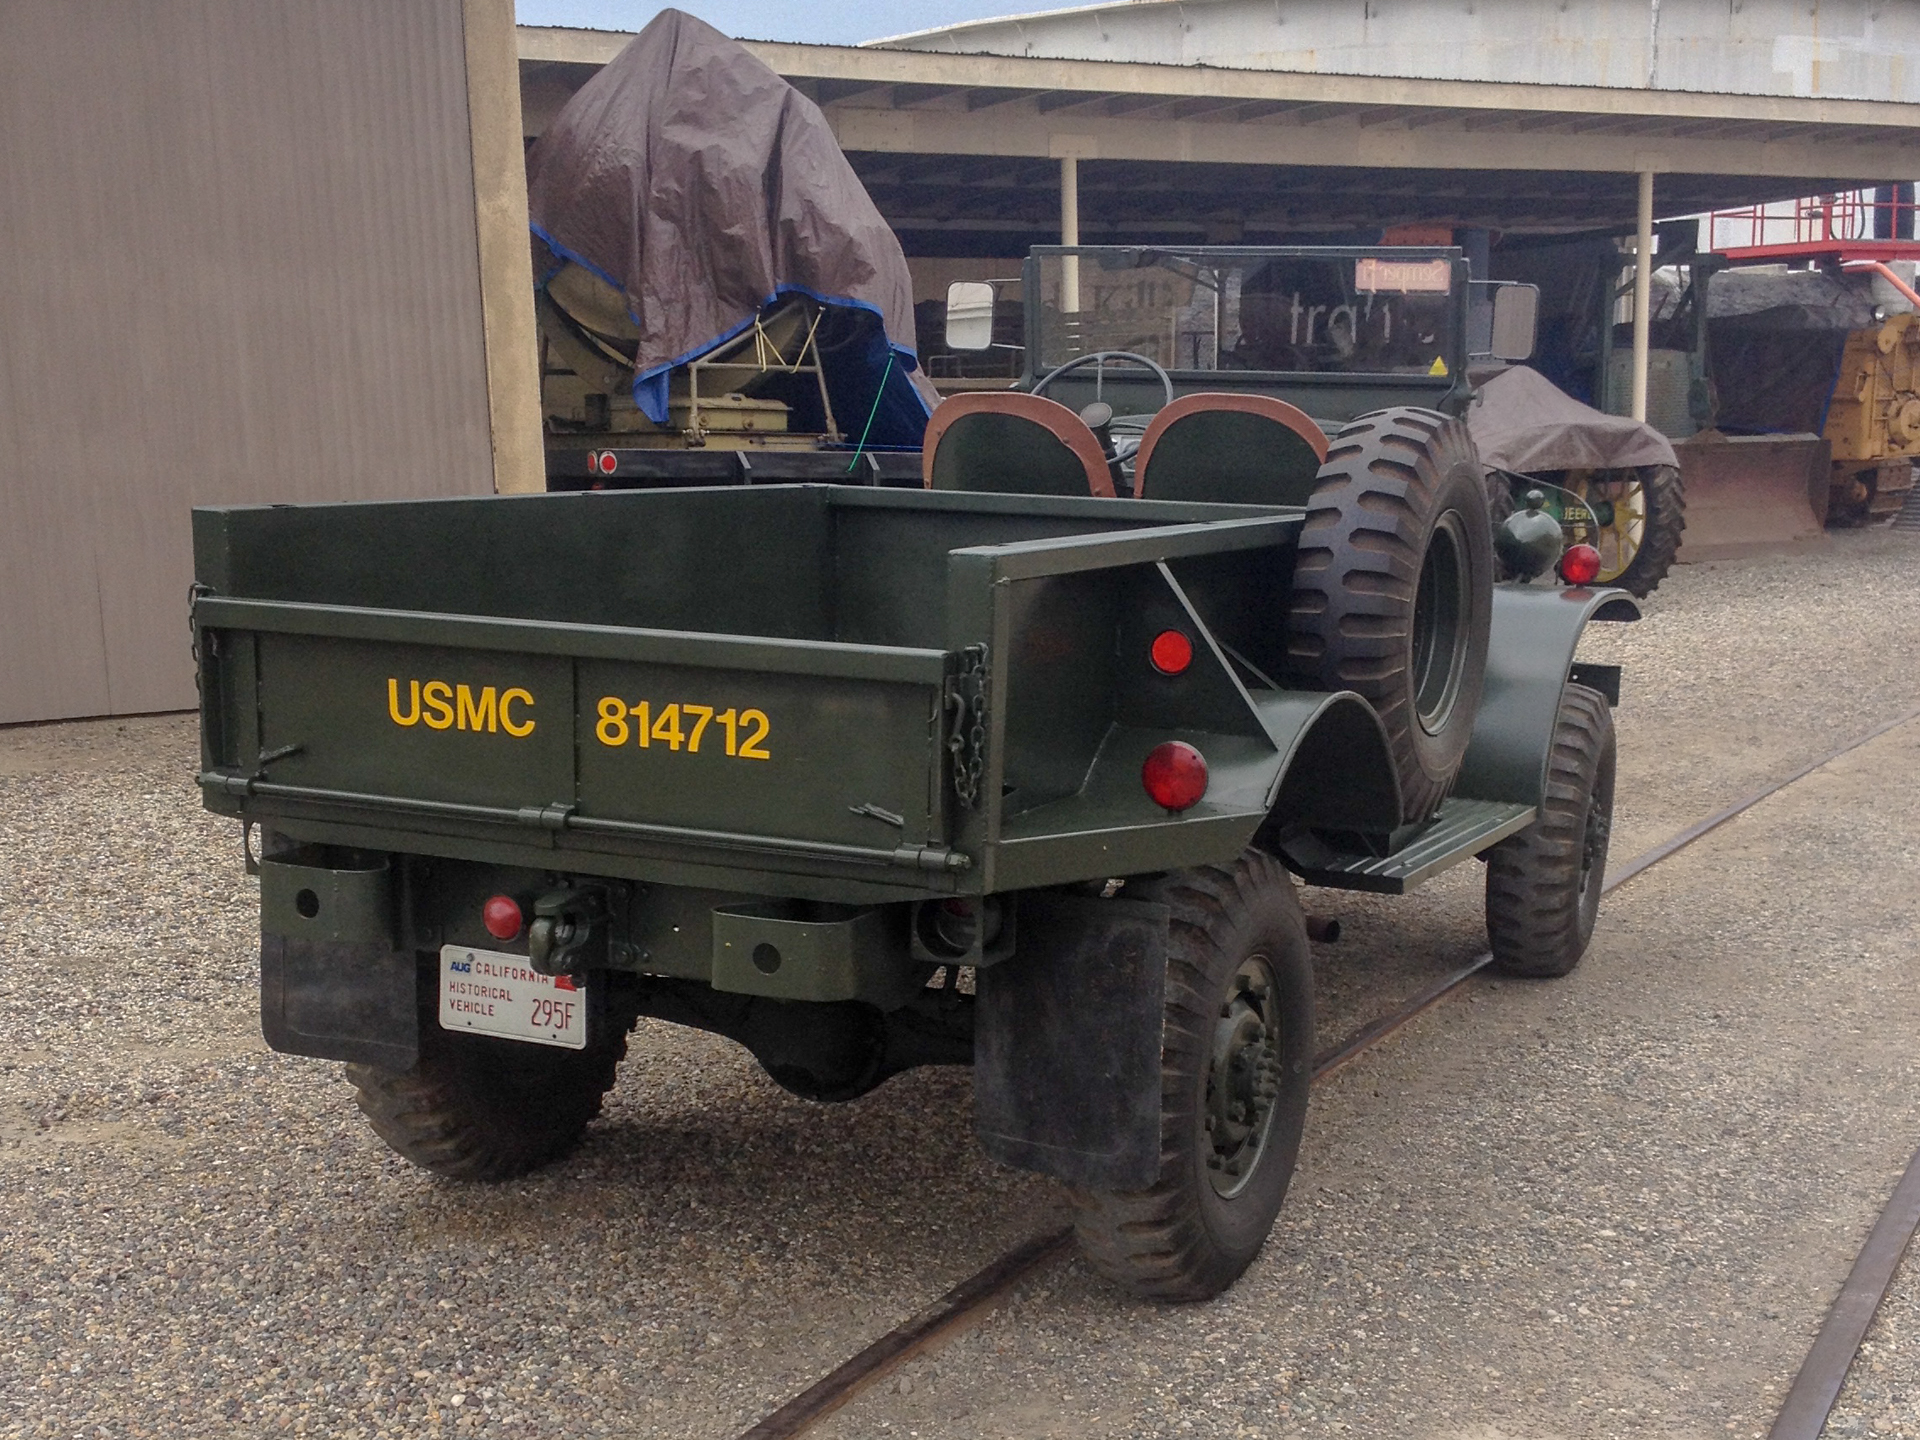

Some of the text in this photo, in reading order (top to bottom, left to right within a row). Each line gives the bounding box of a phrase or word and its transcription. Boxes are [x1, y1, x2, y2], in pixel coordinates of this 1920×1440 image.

[387, 677, 771, 761] USMC 814712
[450, 961, 471, 973] AUG
[475, 962, 549, 984] CALIFORNIA
[449, 981, 513, 1002] HISTORICAL
[449, 998, 495, 1017] VEHICLE
[531, 998, 576, 1030] 295F
